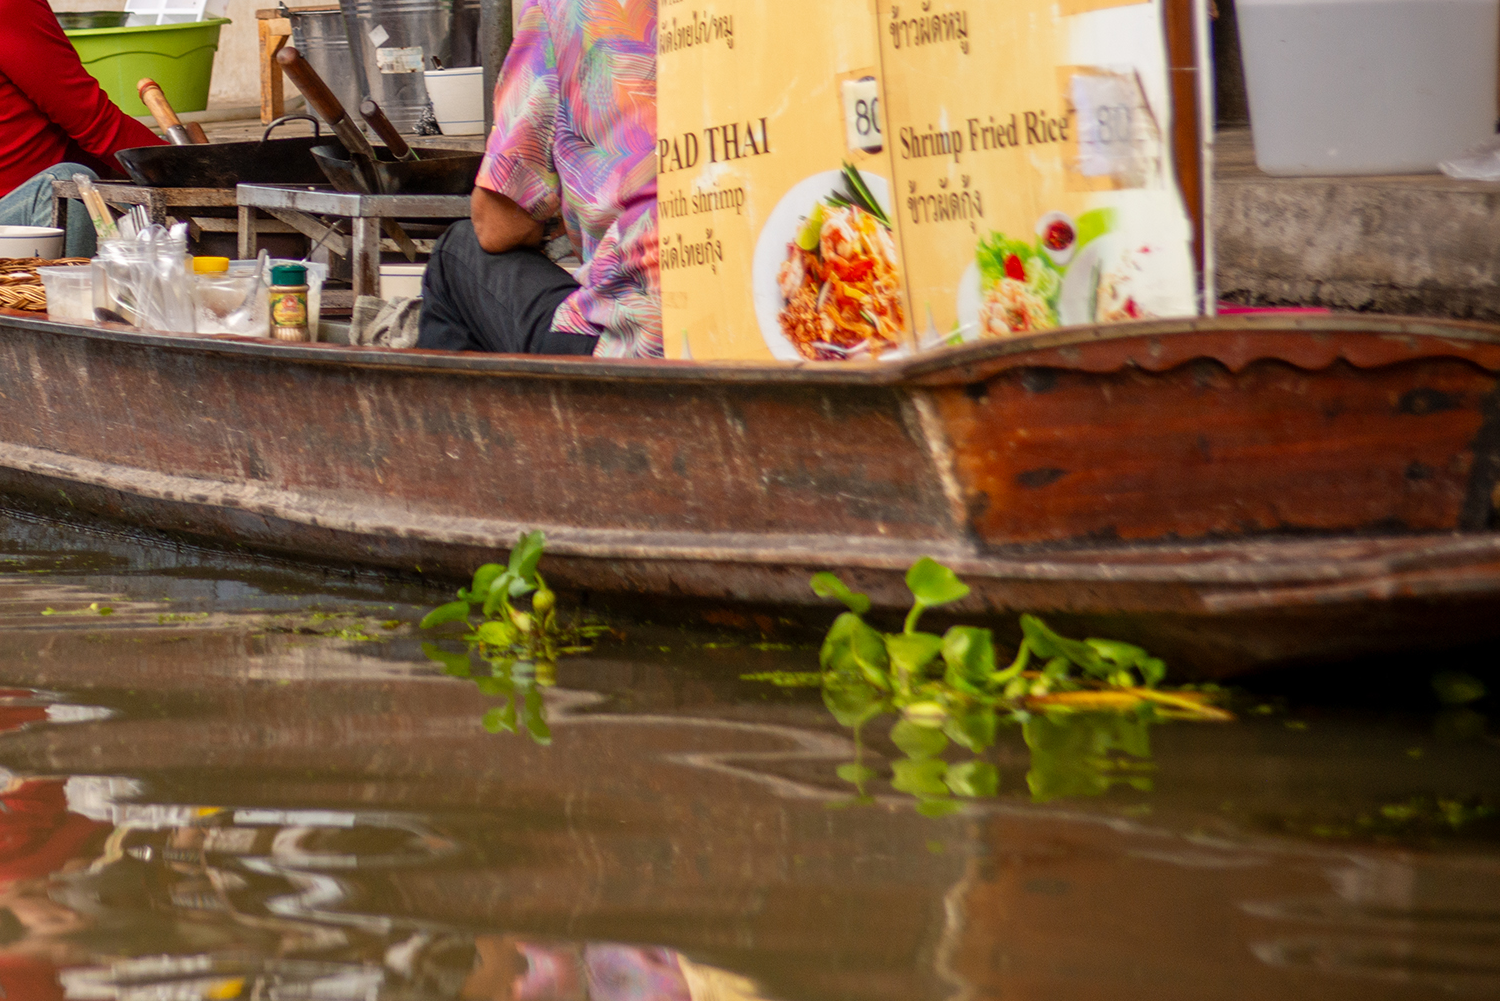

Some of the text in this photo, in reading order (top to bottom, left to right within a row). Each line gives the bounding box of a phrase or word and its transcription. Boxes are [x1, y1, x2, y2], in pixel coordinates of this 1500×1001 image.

[658, 117, 771, 175] PAD THAI
[899, 109, 1069, 164] Shrimp Fried Rice
[658, 182, 745, 220] with shrimp
